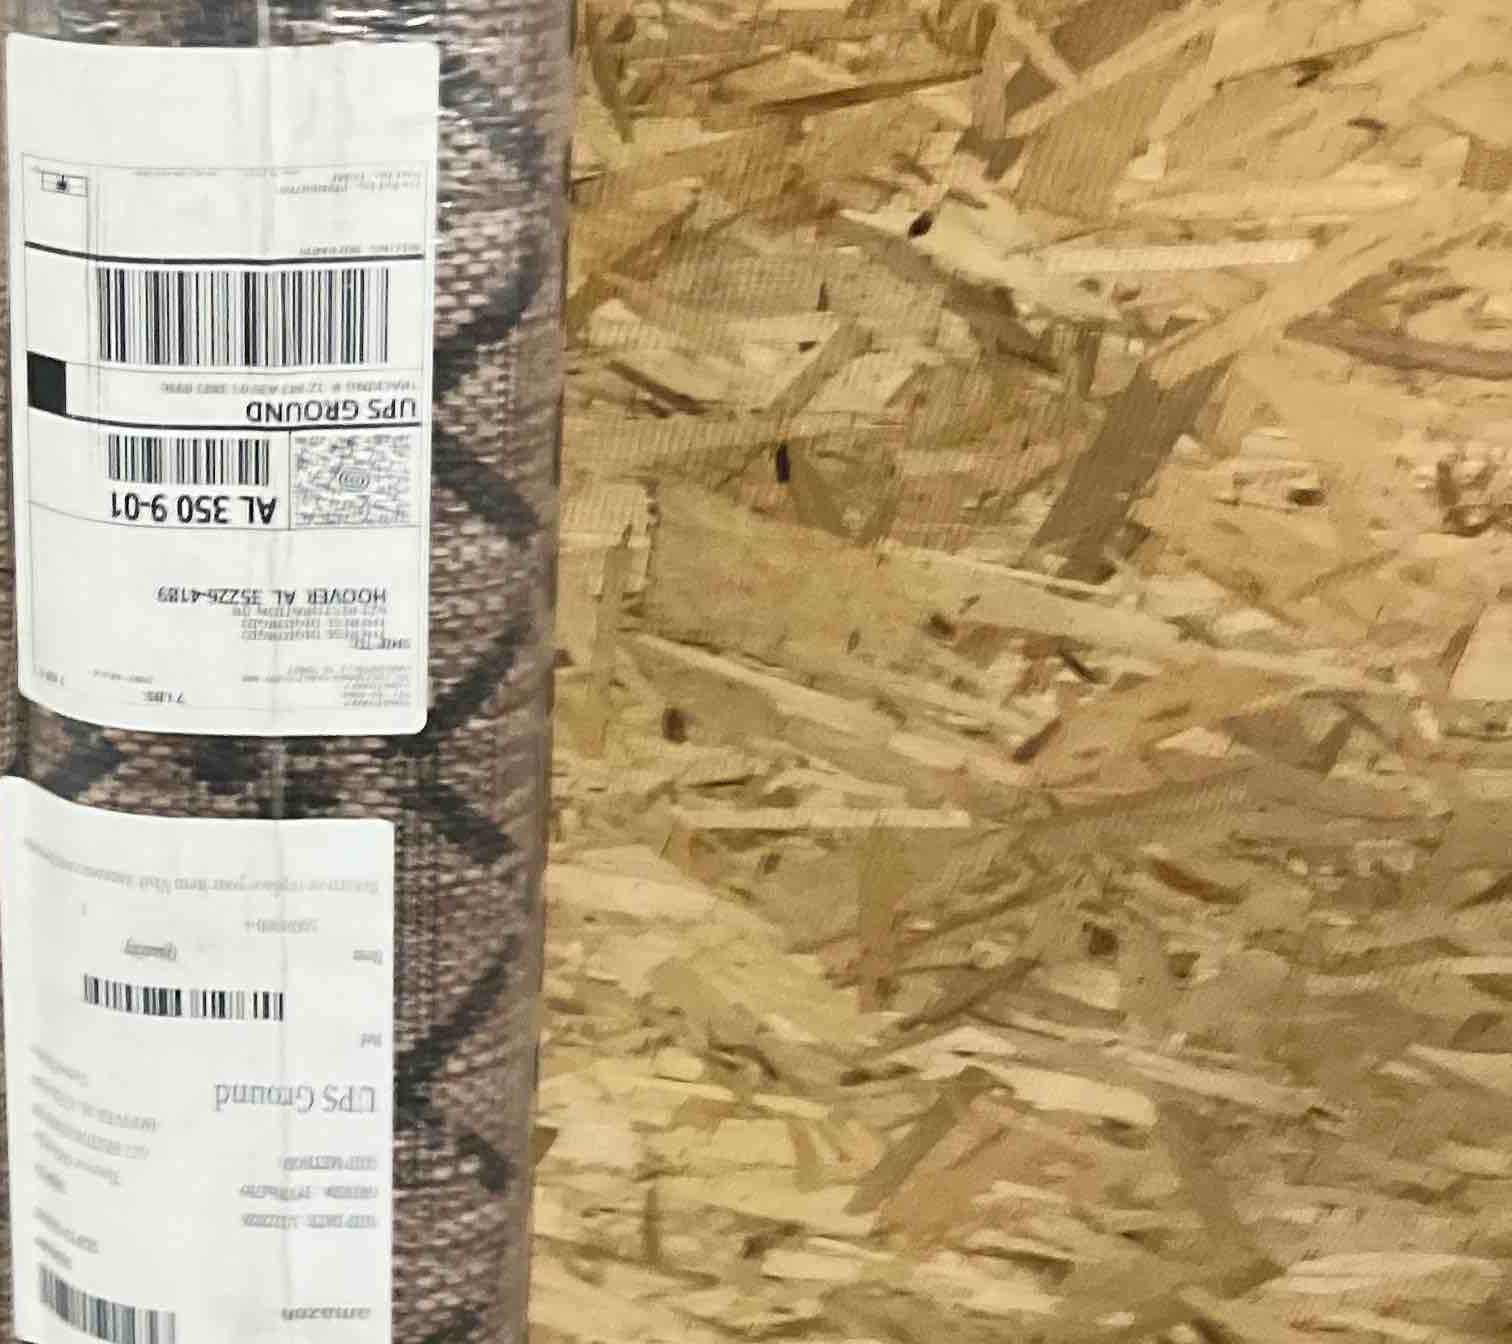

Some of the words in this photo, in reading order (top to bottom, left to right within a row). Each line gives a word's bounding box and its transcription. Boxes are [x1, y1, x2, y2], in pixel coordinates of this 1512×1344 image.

[246, 400, 359, 422] GROUND
[368, 398, 417, 419] UPS
[110, 492, 168, 523] 9-01
[176, 495, 230, 524] 350
[239, 496, 278, 524] AL
[272, 590, 296, 607] AL
[306, 588, 386, 606] HOOVER
[214, 1084, 314, 1113] Ground
[322, 1084, 376, 1114] UPS
[282, 1307, 370, 1322] amazon
